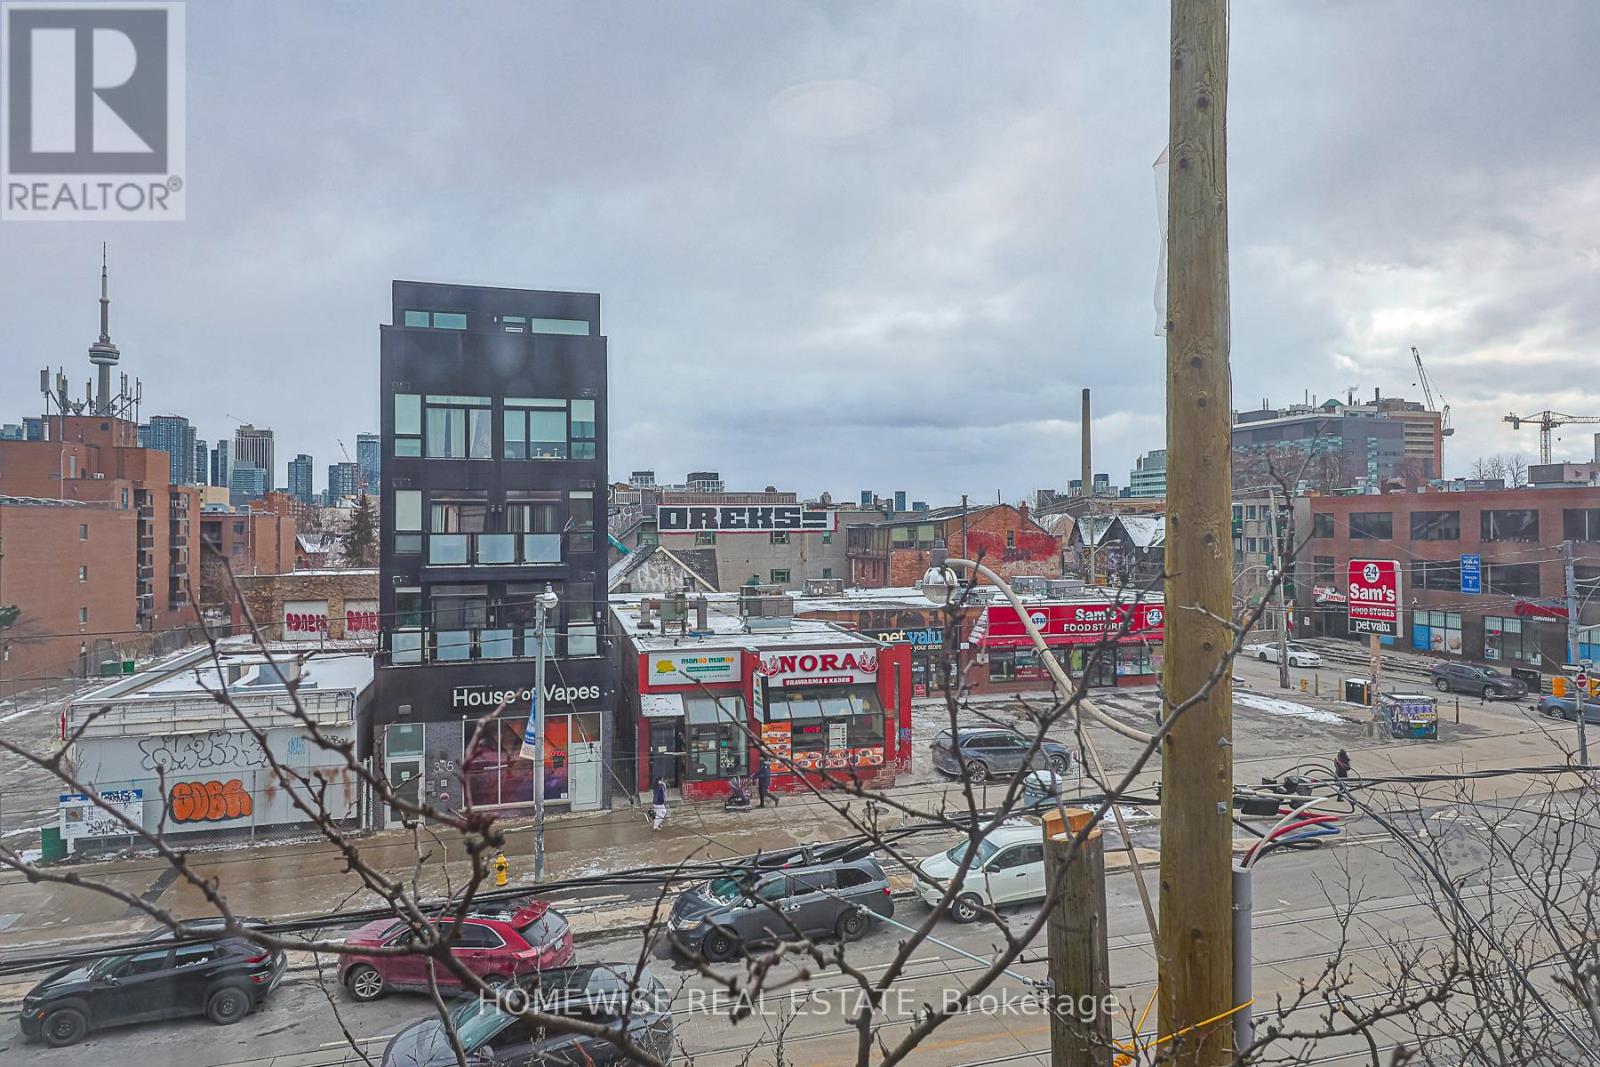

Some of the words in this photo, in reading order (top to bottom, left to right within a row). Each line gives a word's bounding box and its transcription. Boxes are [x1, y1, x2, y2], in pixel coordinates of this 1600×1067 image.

[1365, 566, 1378, 577] 24
[1350, 583, 1395, 602] Sam's
[1075, 608, 1117, 621] Sam's
[1063, 623, 1091, 632] FOOD
[1355, 621, 1370, 632] pet
[1371, 622, 1391, 632] valu
[907, 627, 943, 645] valu
[779, 653, 859, 673] NORA
[453, 689, 516, 707] House
[543, 684, 600, 704] Vapes
